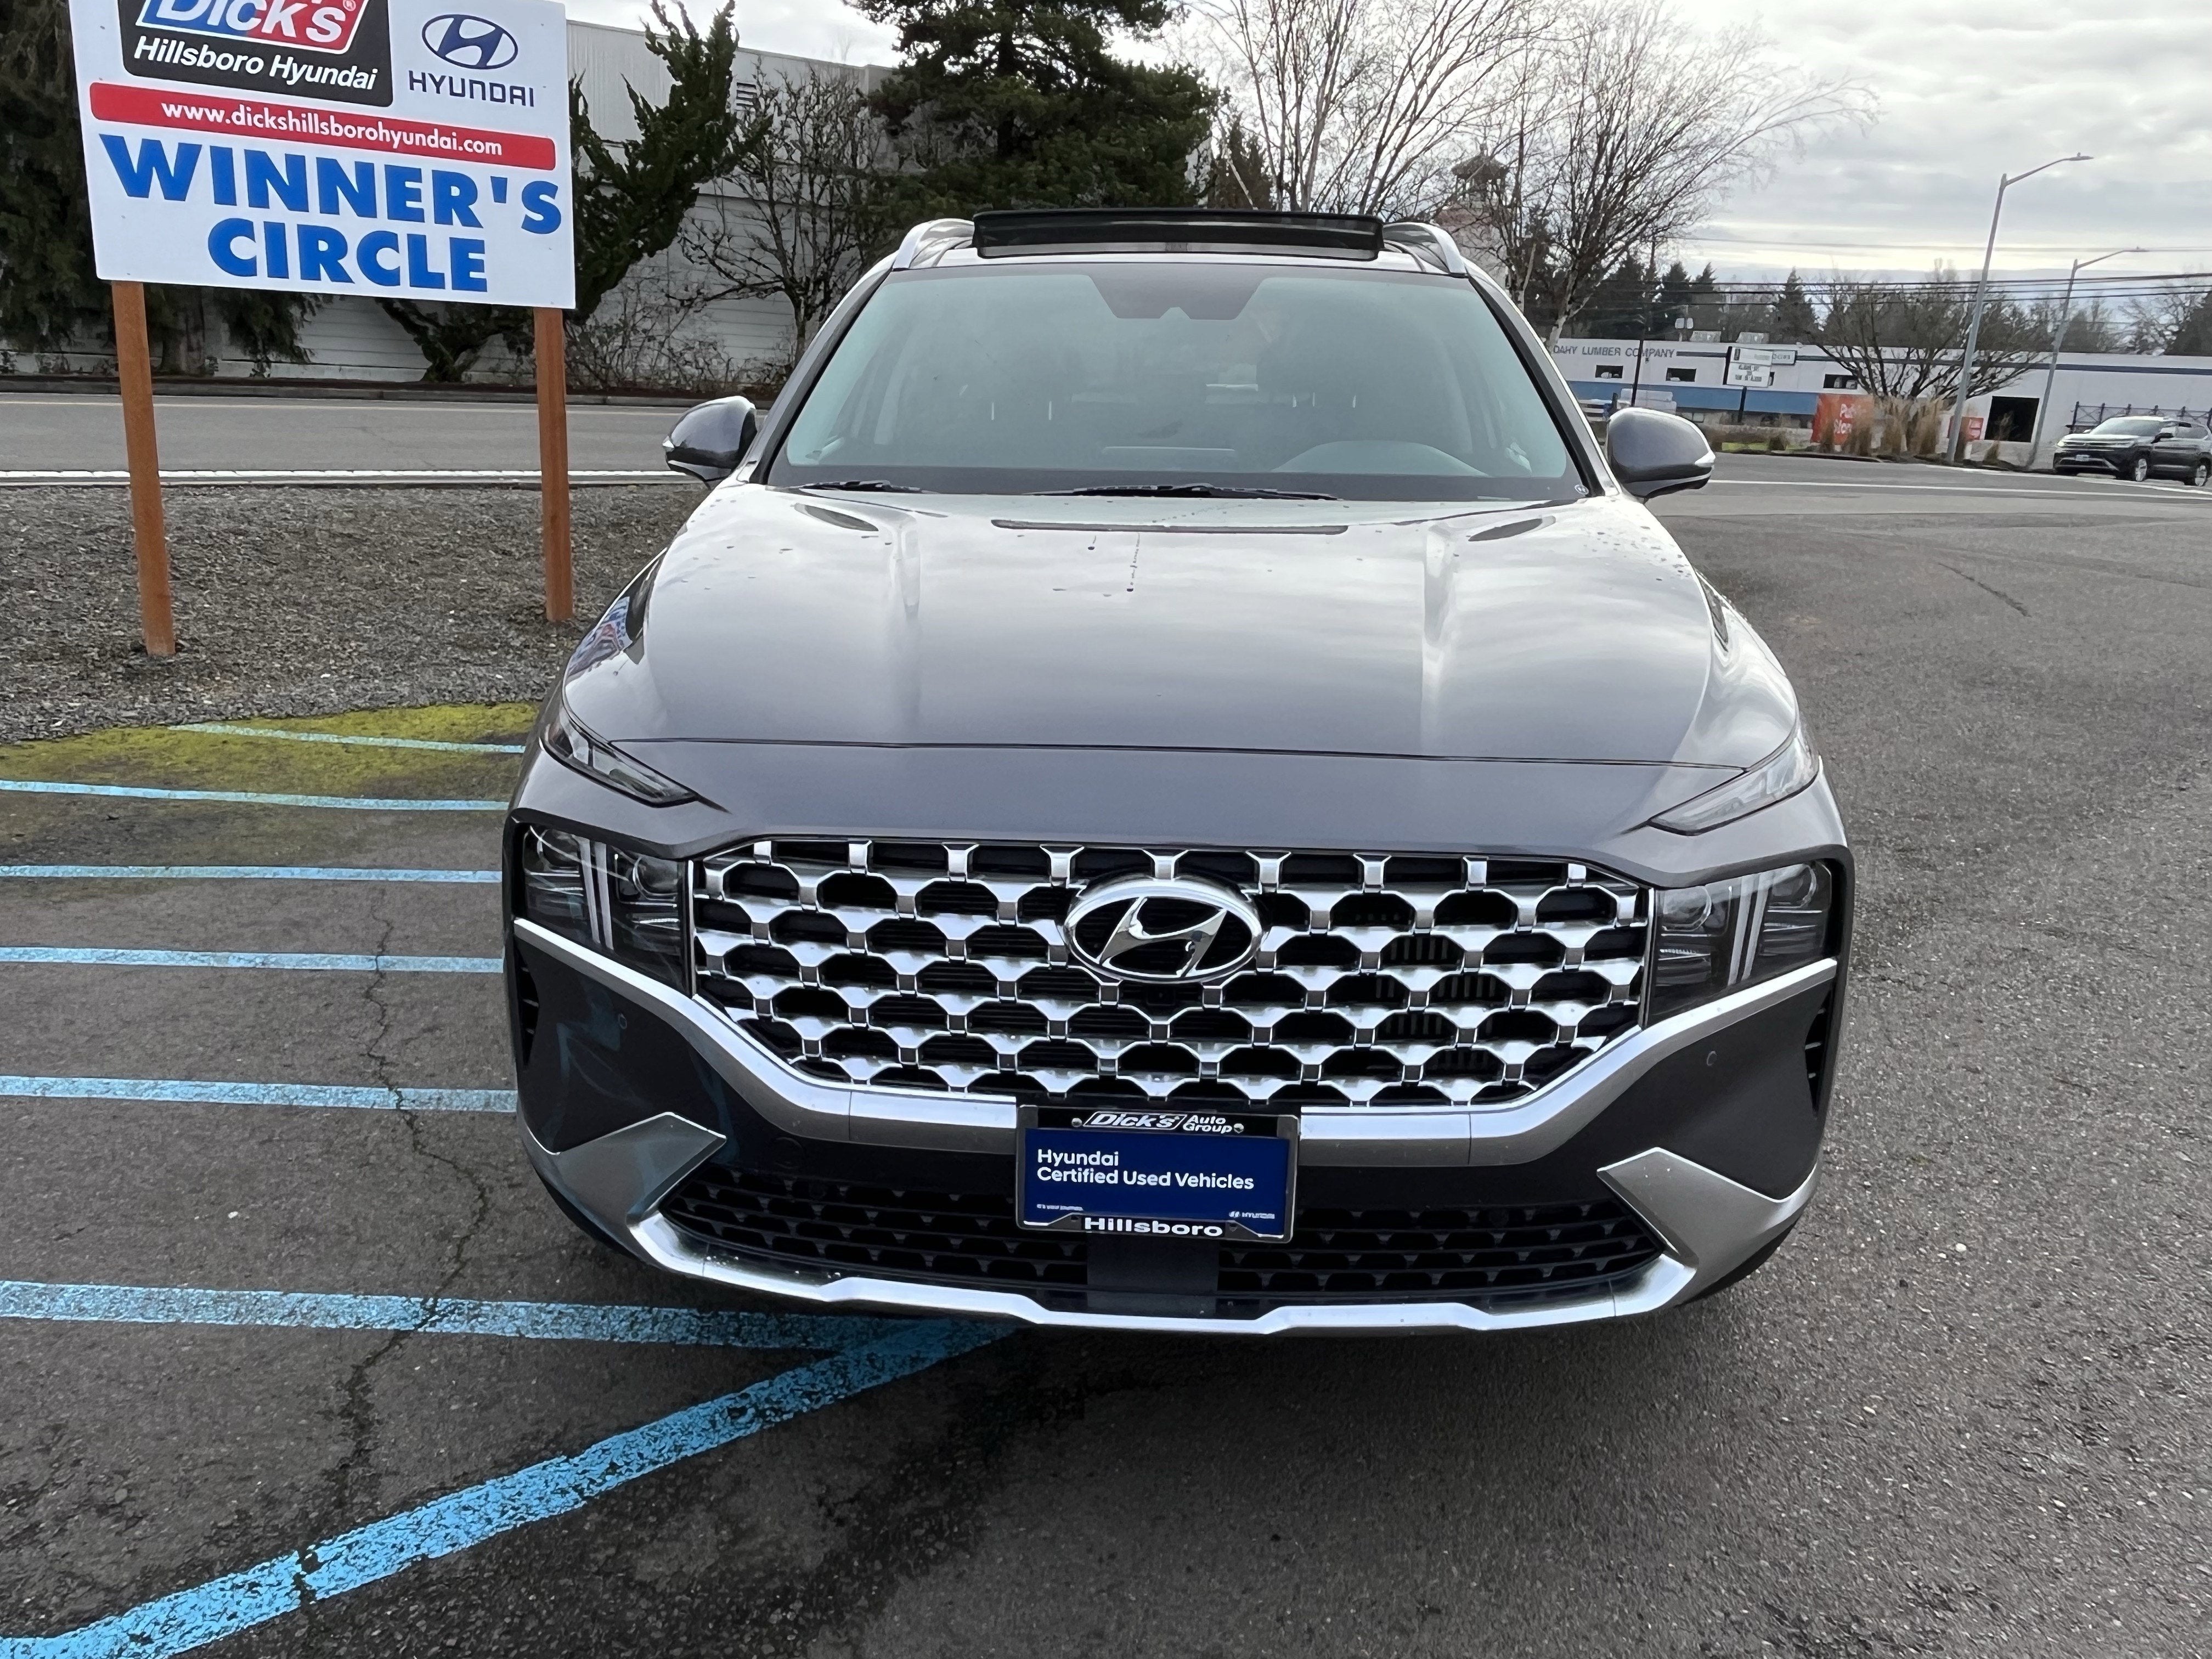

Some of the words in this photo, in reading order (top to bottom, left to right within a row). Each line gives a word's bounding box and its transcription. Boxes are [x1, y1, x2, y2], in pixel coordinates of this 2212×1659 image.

[156, 0, 346, 42] Dicks
[134, 36, 264, 75] Hillsboro
[269, 55, 378, 89] Hyundai
[409, 70, 534, 107] HYUNDAI
[161, 103, 502, 155] www.dickshillsborohyundai.com
[99, 134, 561, 234] WINNER'S
[208, 218, 488, 292] CIRCLE
[1582, 346, 1621, 356] LUMBER
[1625, 347, 1675, 358] COMPANY
[1091, 1114, 1177, 1128] Dick's
[1183, 1122, 1233, 1133] Group
[1186, 1115, 1226, 1124] Auto
[1037, 1149, 1119, 1166] Hyundai
[1037, 1166, 1118, 1184] Certified
[1123, 1171, 1171, 1186] Used
[1175, 1172, 1255, 1189] Vehicles
[1085, 1217, 1223, 1237] Hillsboro
